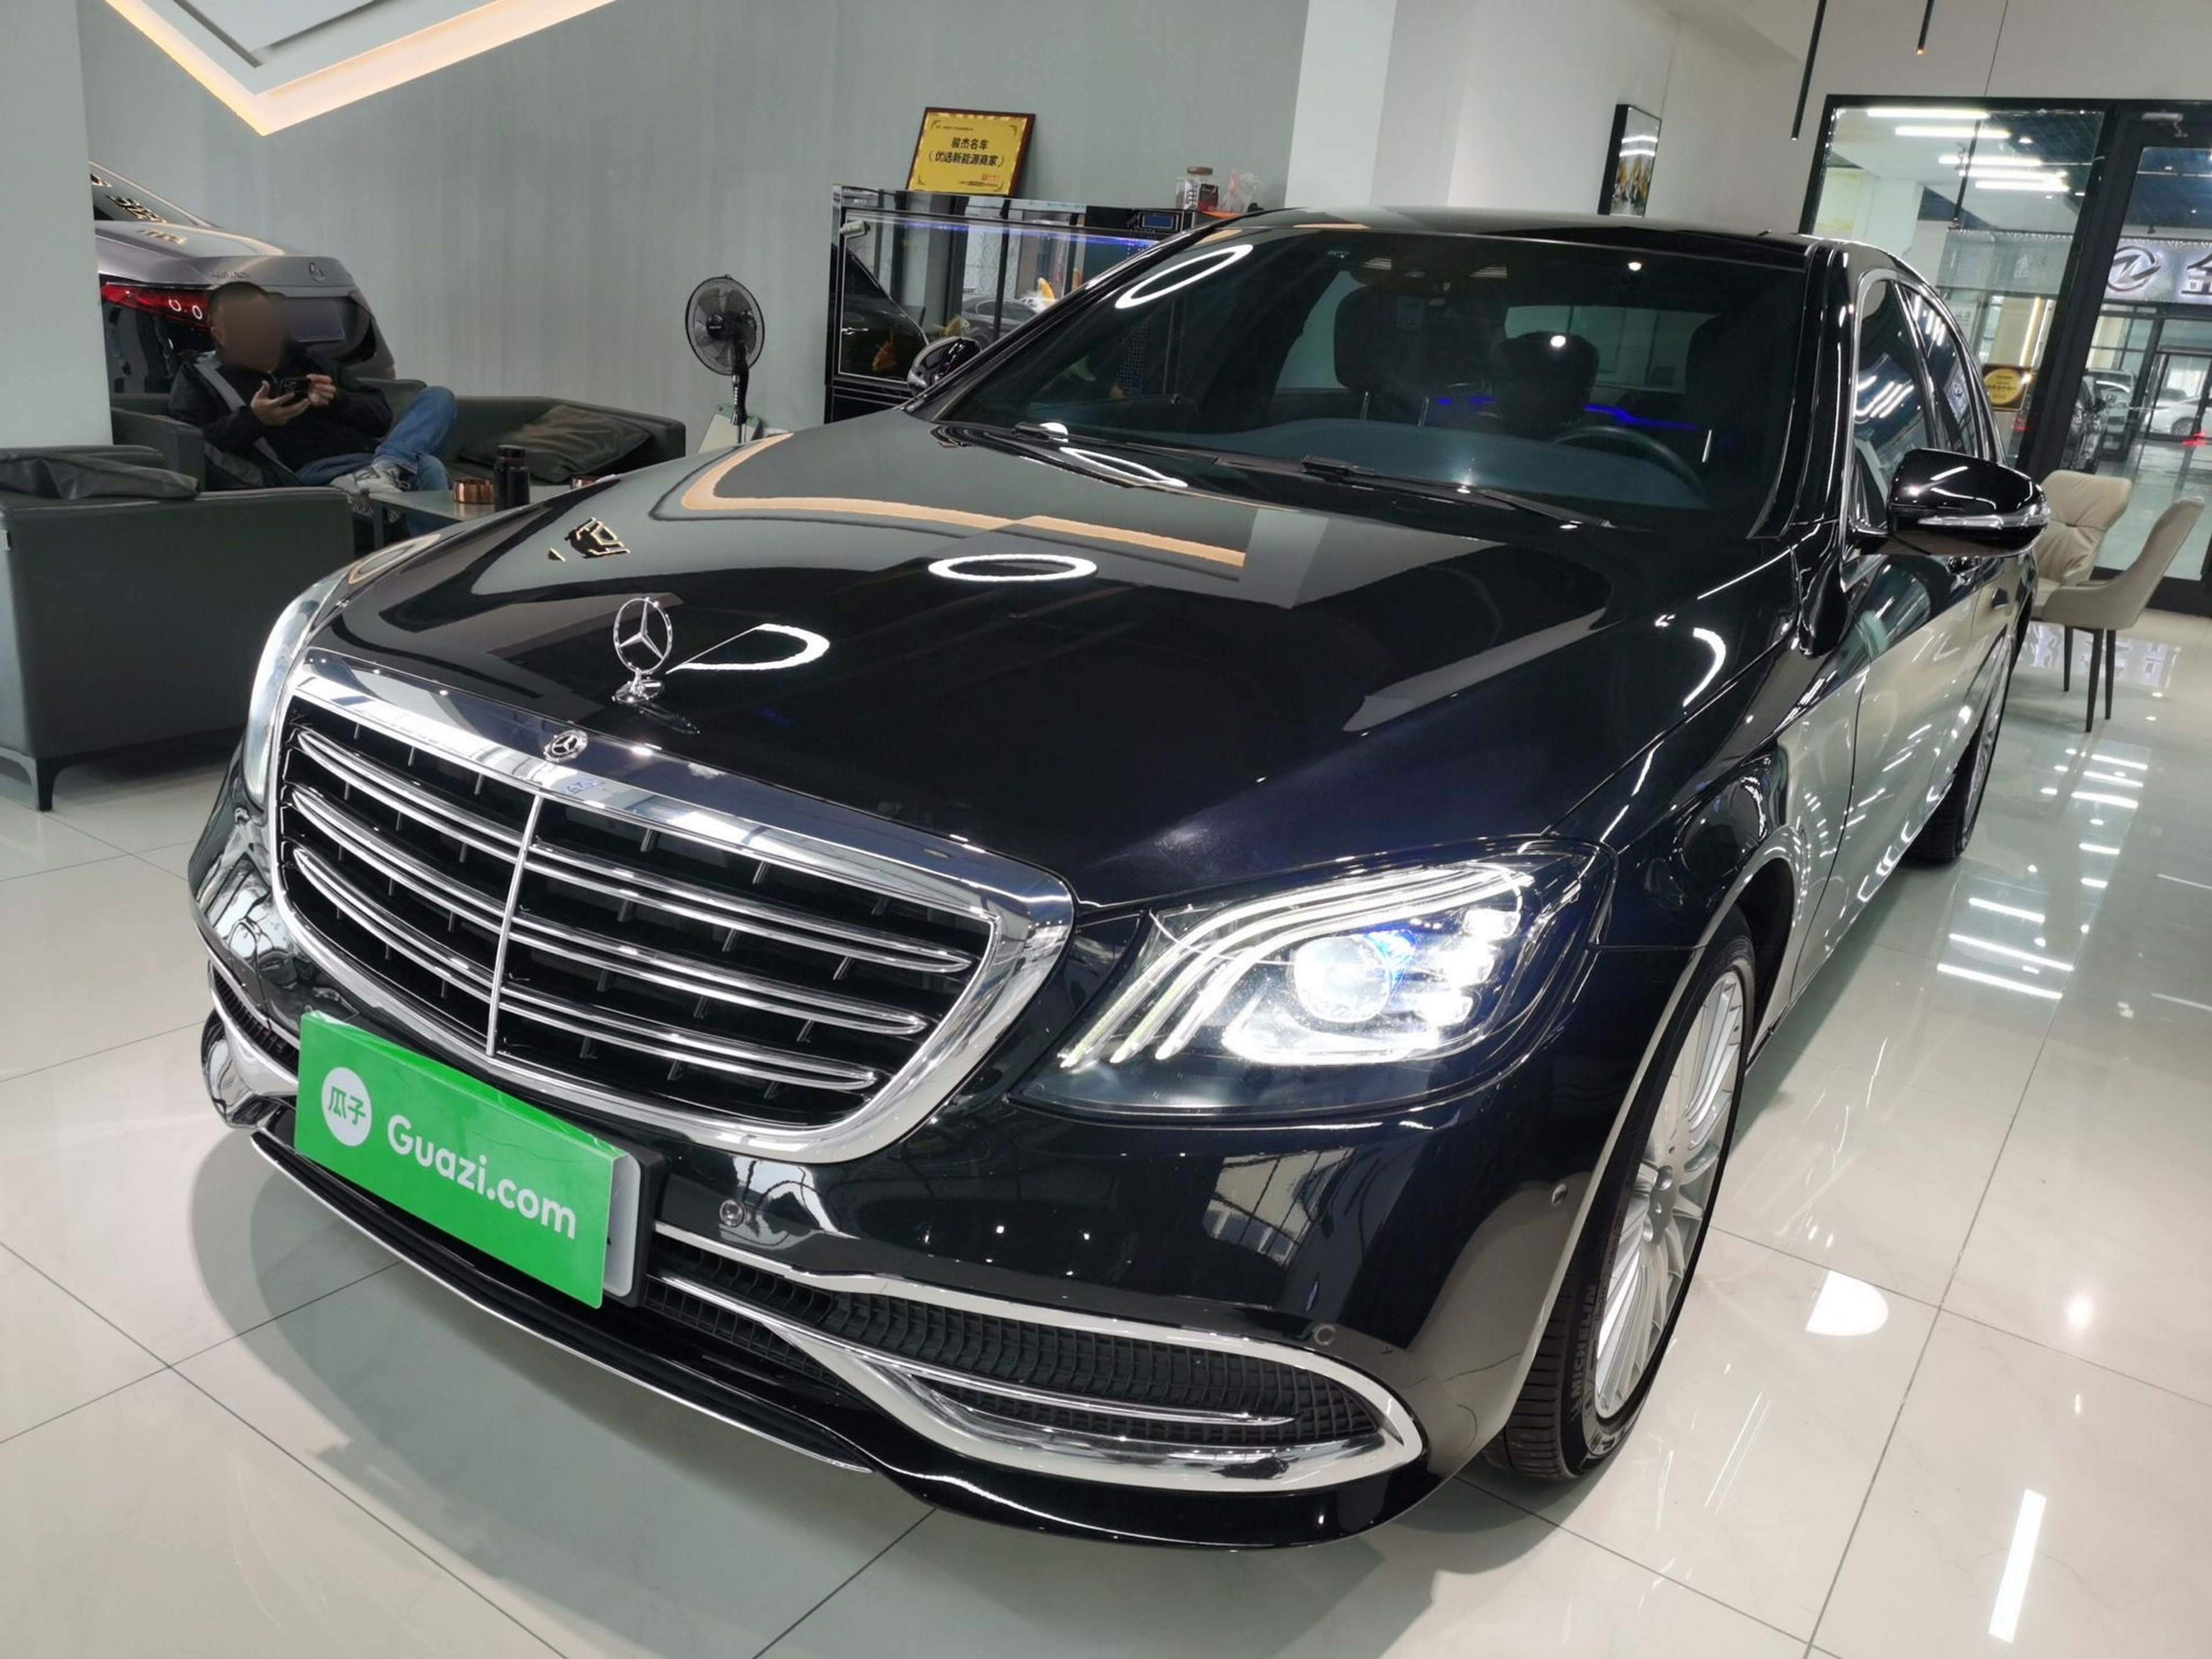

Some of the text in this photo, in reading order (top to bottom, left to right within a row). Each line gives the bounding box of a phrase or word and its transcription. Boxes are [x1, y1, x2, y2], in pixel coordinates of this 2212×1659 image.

[328, 1086, 366, 1126] 瓜子
[387, 1114, 577, 1240] Guazi.com
[1570, 1281, 1598, 1399] MICHELIN
